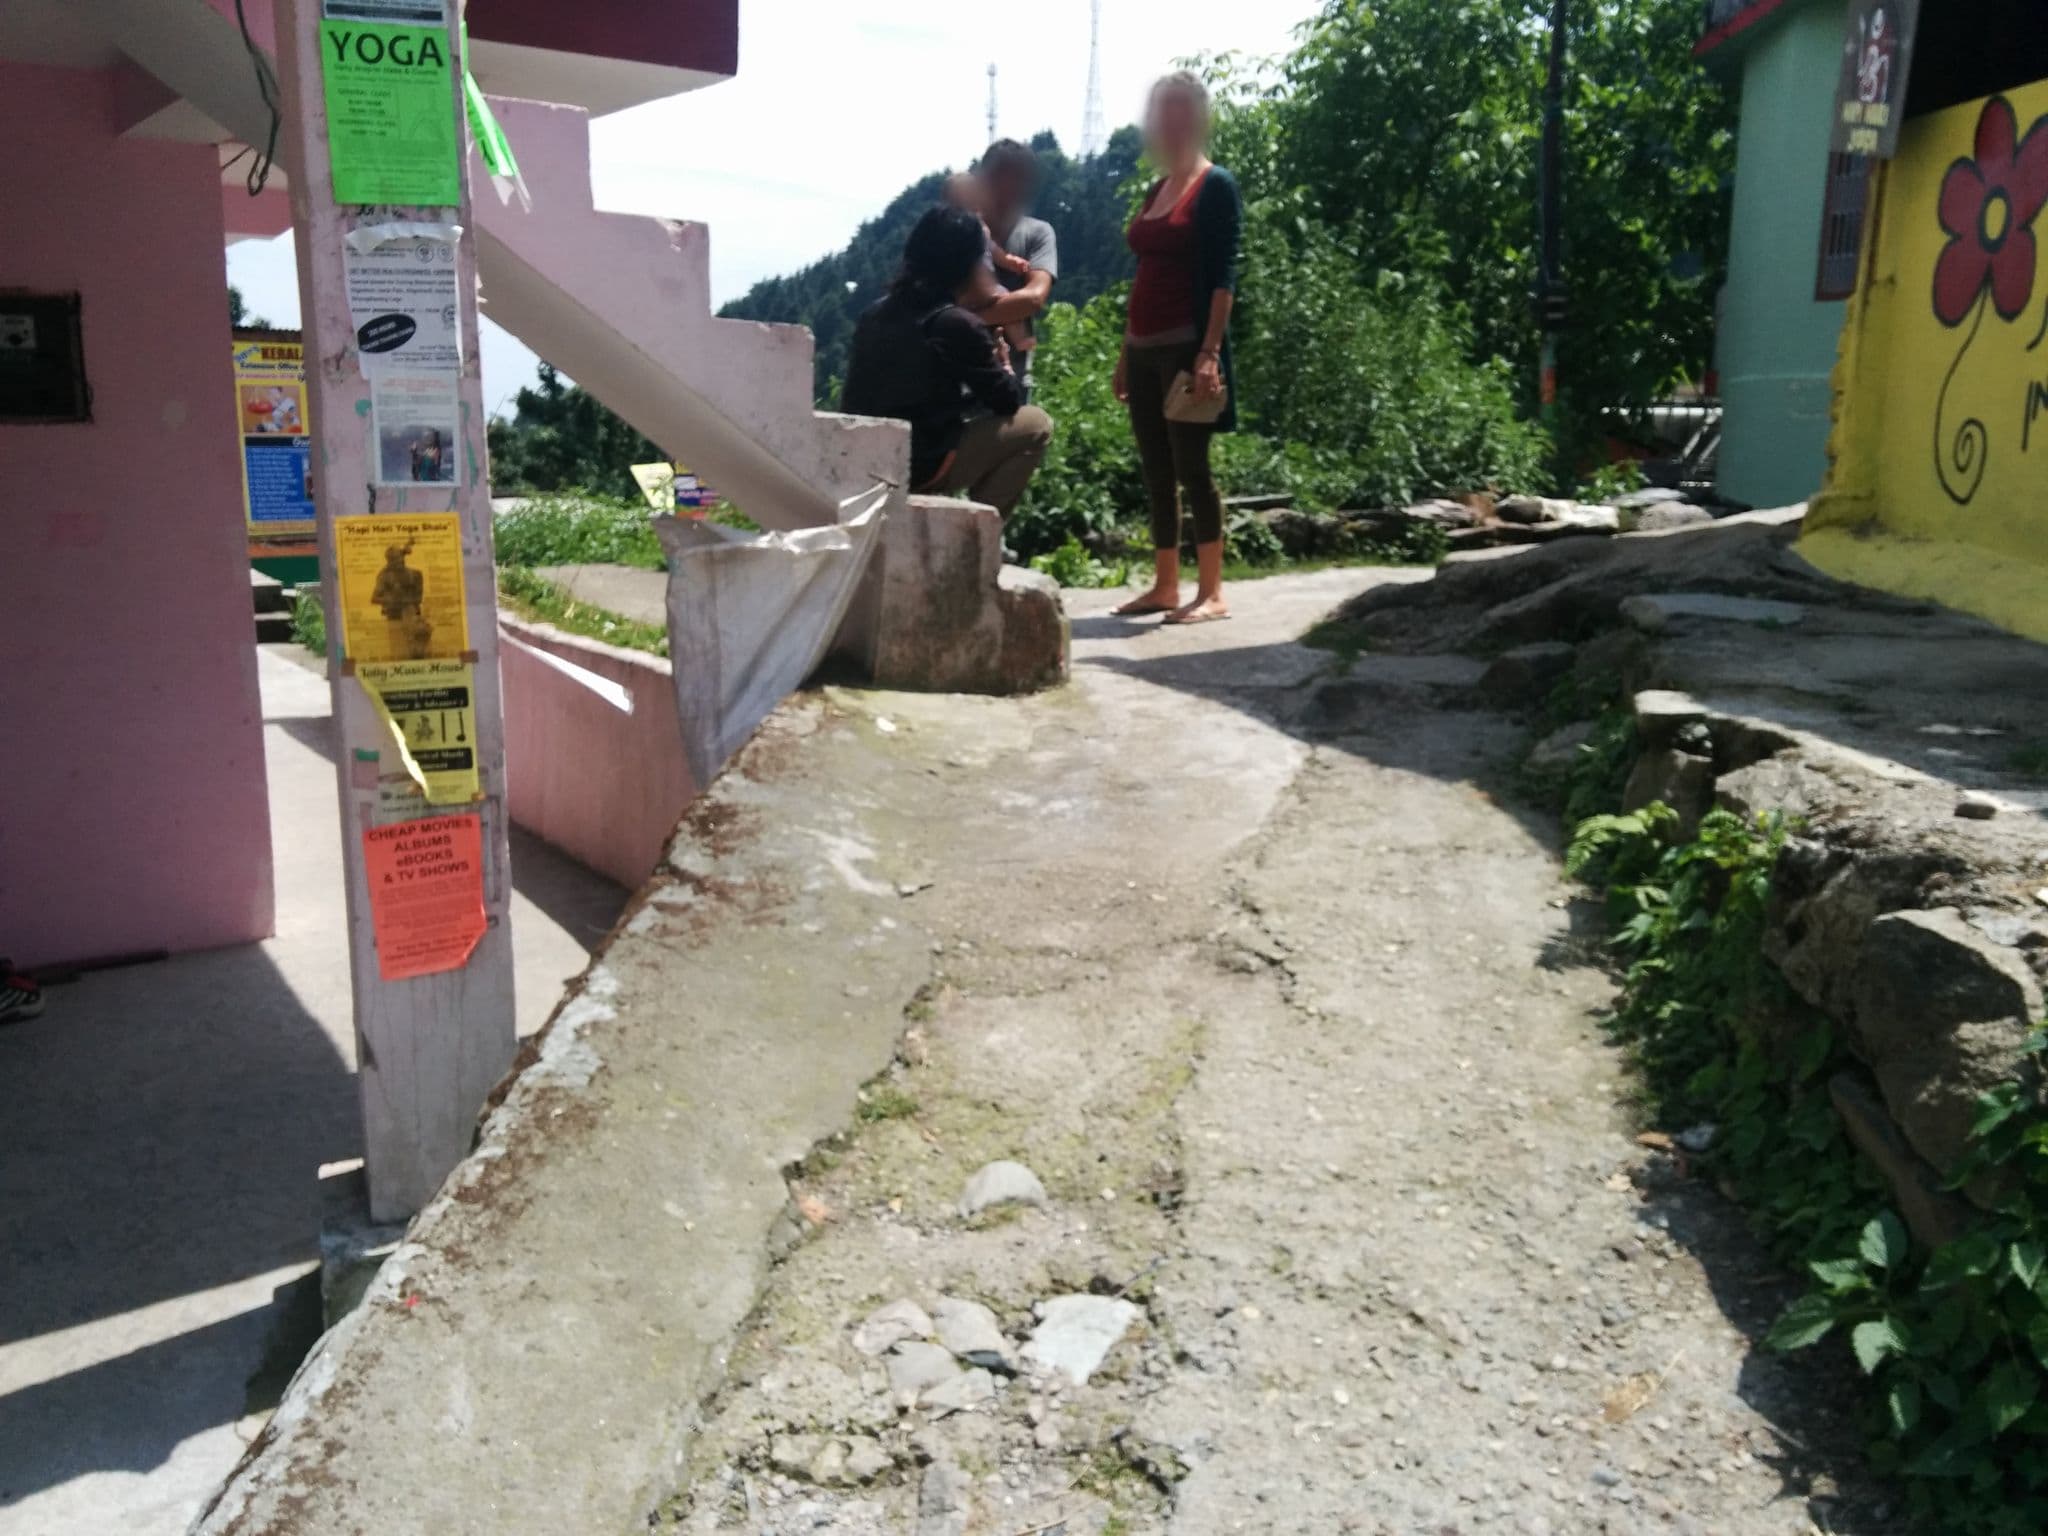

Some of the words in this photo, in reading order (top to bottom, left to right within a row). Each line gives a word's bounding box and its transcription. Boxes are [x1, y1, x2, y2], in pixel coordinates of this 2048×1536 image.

[328, 30, 444, 68] YOGA
[396, 523, 418, 535] Yoga
[390, 664, 425, 677] Music
[429, 661, 465, 674] House
[368, 824, 416, 842] CHEAP
[420, 818, 473, 834] MOVIES
[394, 835, 452, 852] ALBUMS
[396, 850, 453, 867] eBOOKS
[384, 873, 393, 884] &
[398, 870, 415, 882] TV
[419, 861, 470, 878] SHOWS
